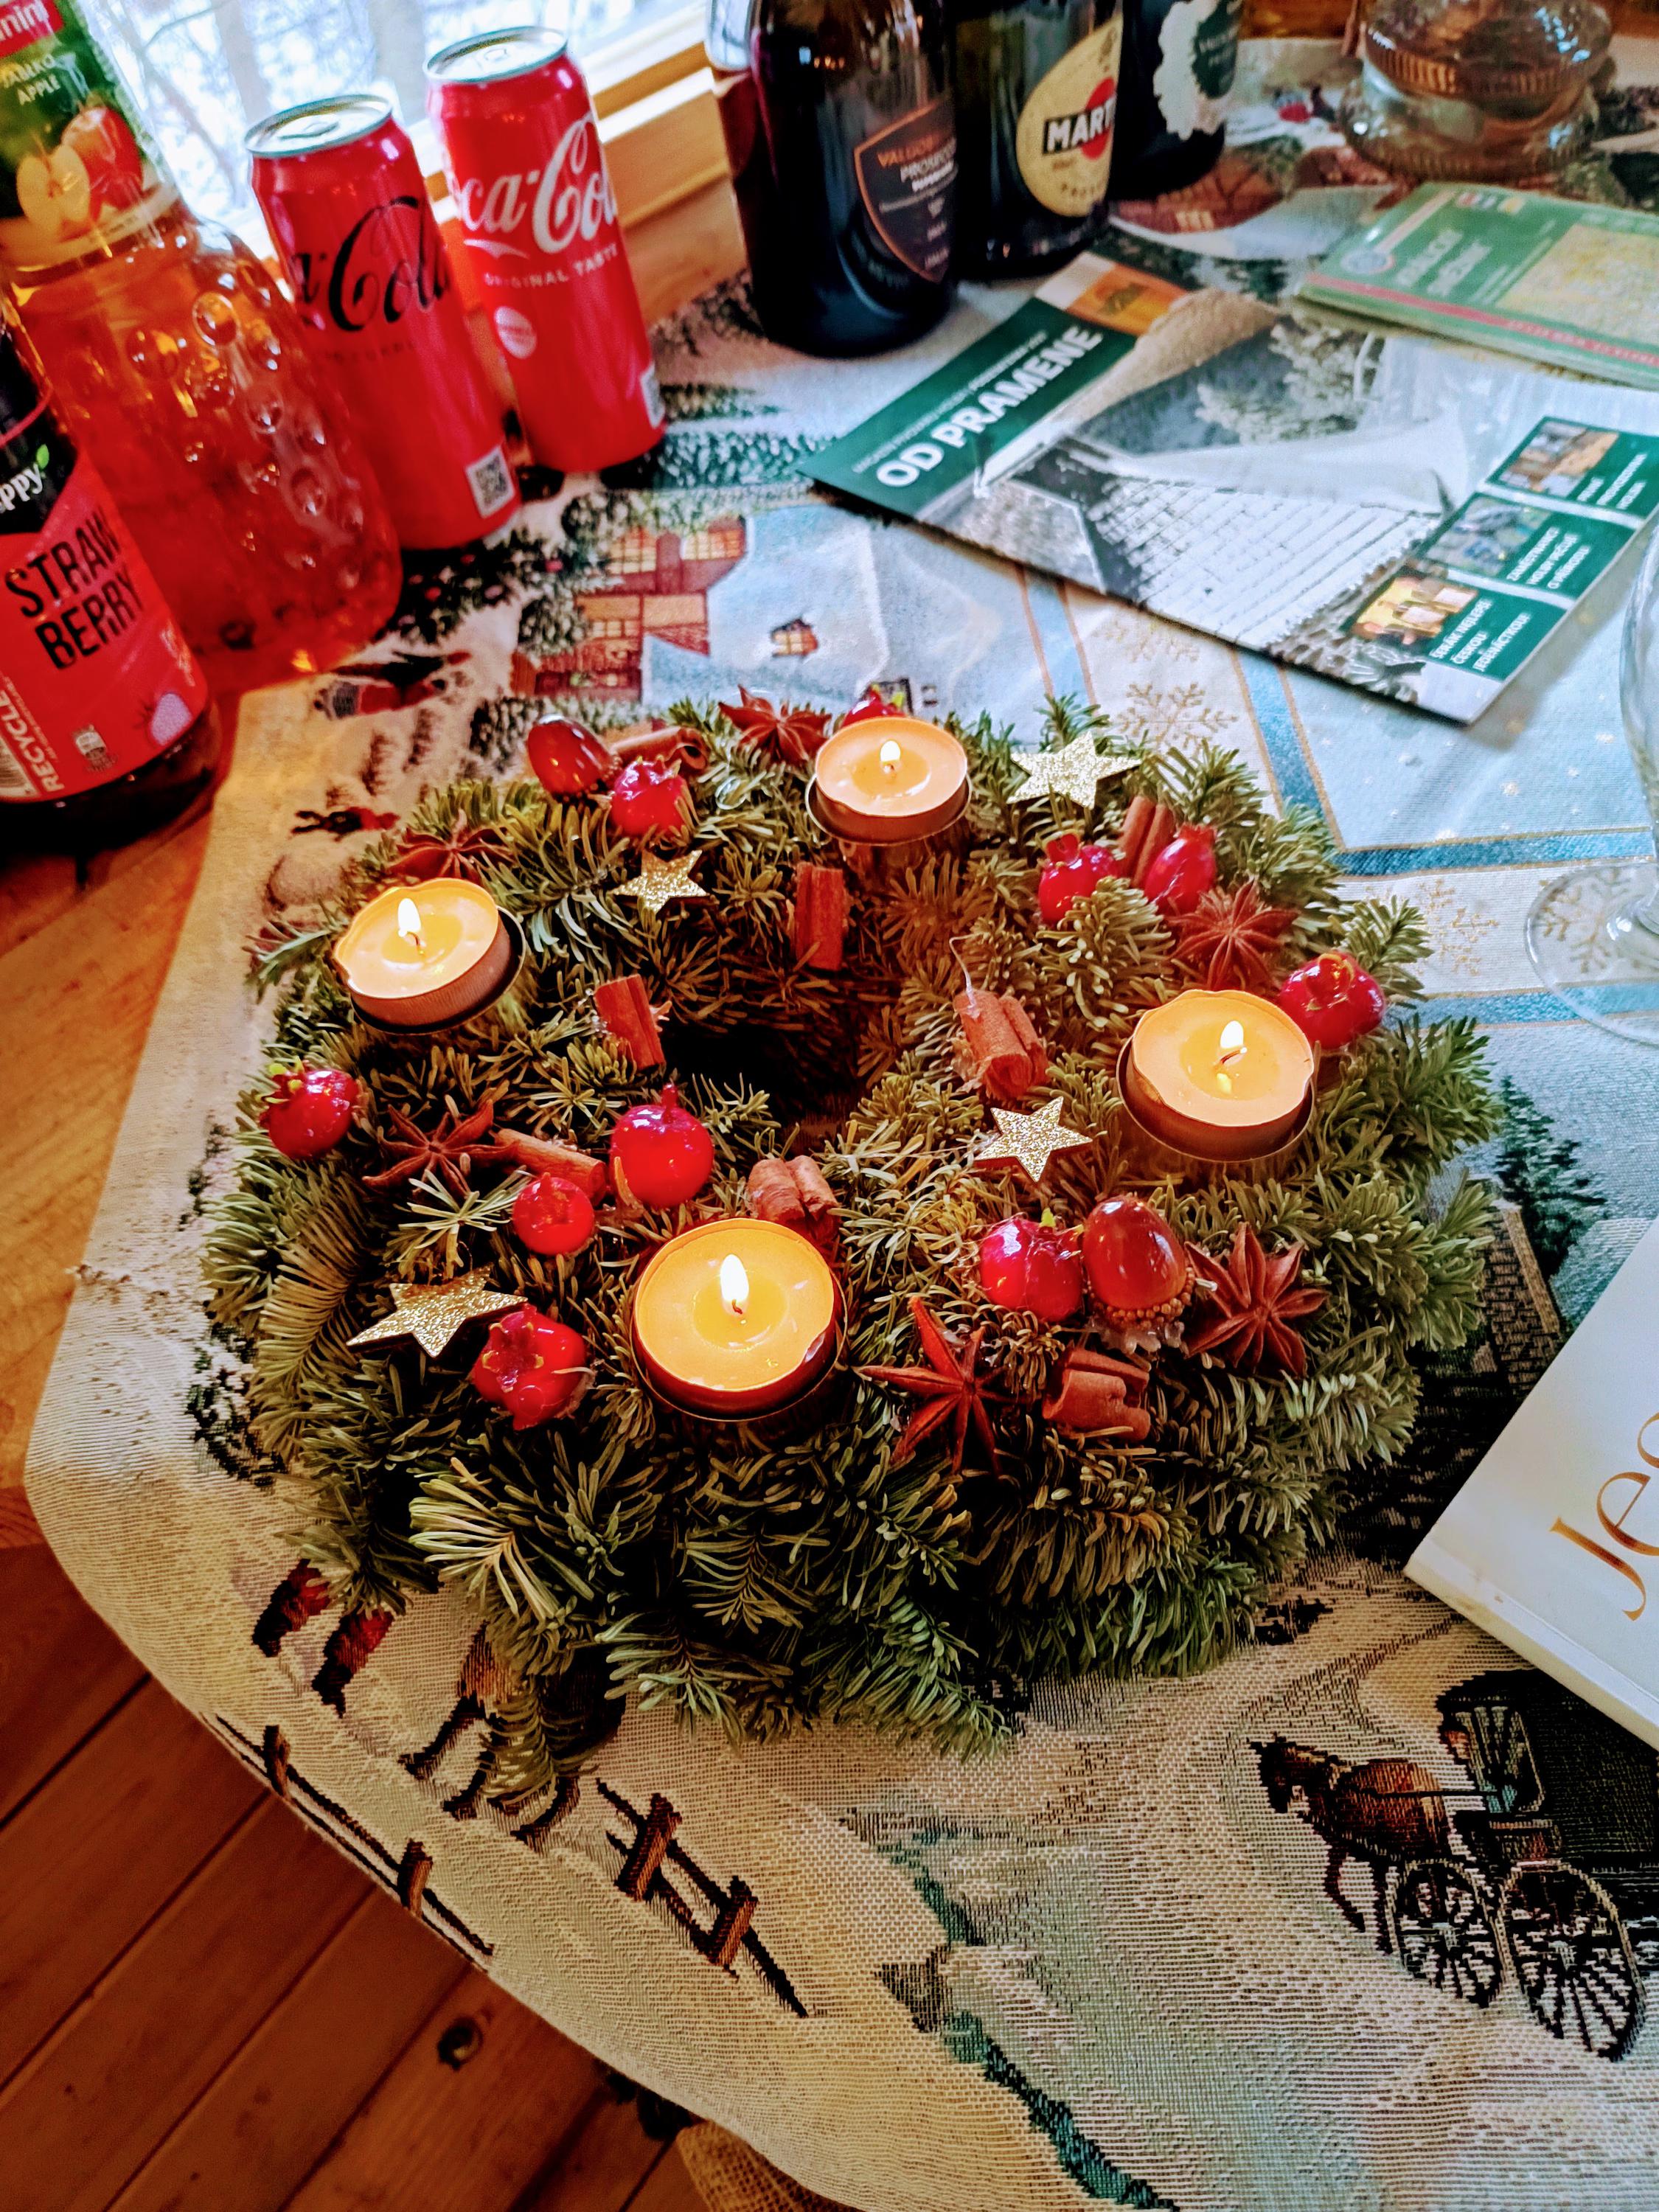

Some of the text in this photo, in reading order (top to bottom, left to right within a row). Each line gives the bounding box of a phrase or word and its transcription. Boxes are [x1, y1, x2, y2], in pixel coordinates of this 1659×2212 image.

[17, 74, 60, 105] APPLE
[875, 441, 945, 488] OD
[932, 326, 1105, 448] PRAMENE
[0, 462, 46, 512] ppy
[4, 508, 122, 617] STRAW
[35, 563, 143, 669] BERRY
